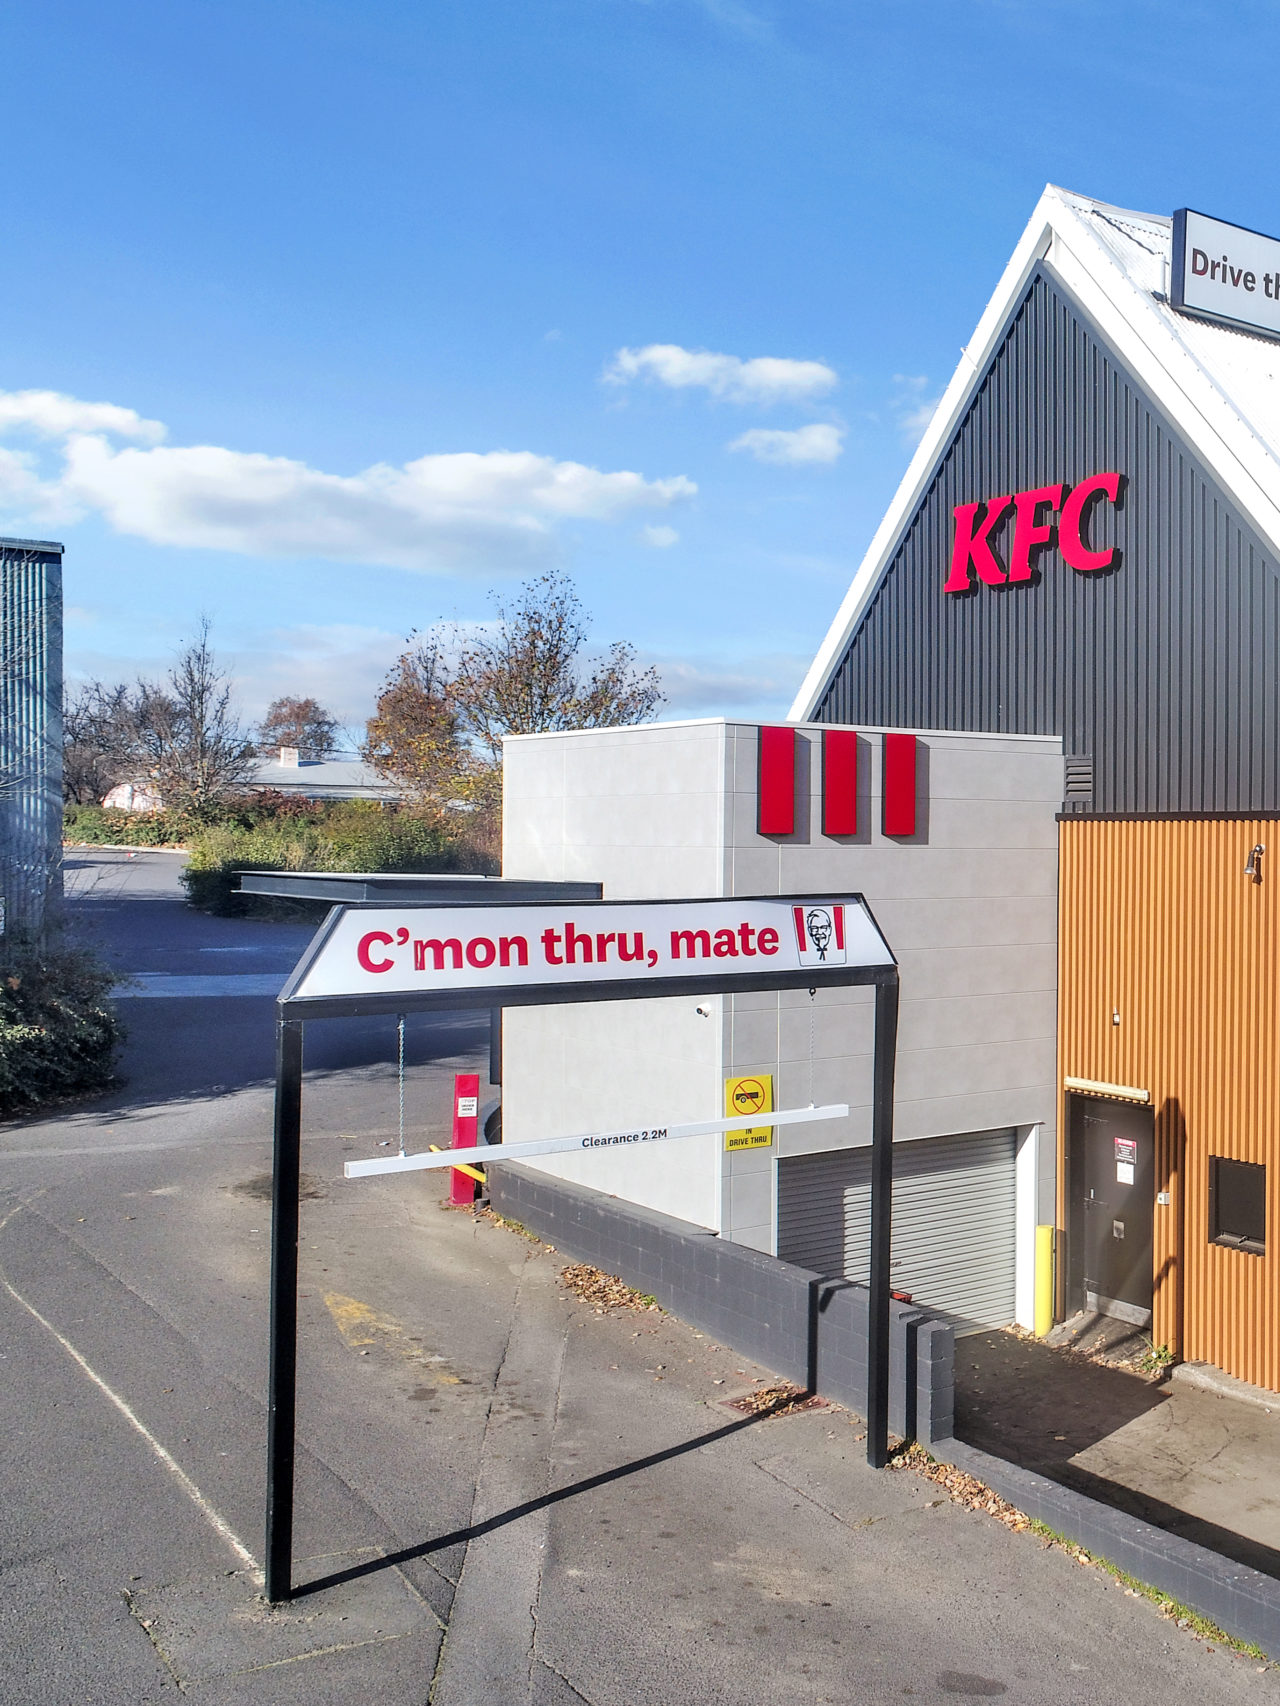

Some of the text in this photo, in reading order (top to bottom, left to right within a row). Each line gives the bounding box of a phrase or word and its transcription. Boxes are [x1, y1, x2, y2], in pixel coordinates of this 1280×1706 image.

[1191, 247, 1256, 292] Drive
[944, 472, 1121, 593] KFC
[357, 922, 779, 974] C'mon thru, mate
[582, 1128, 667, 1148] Clearance 2.2M
[729, 1135, 768, 1147] DRIVE THRU
